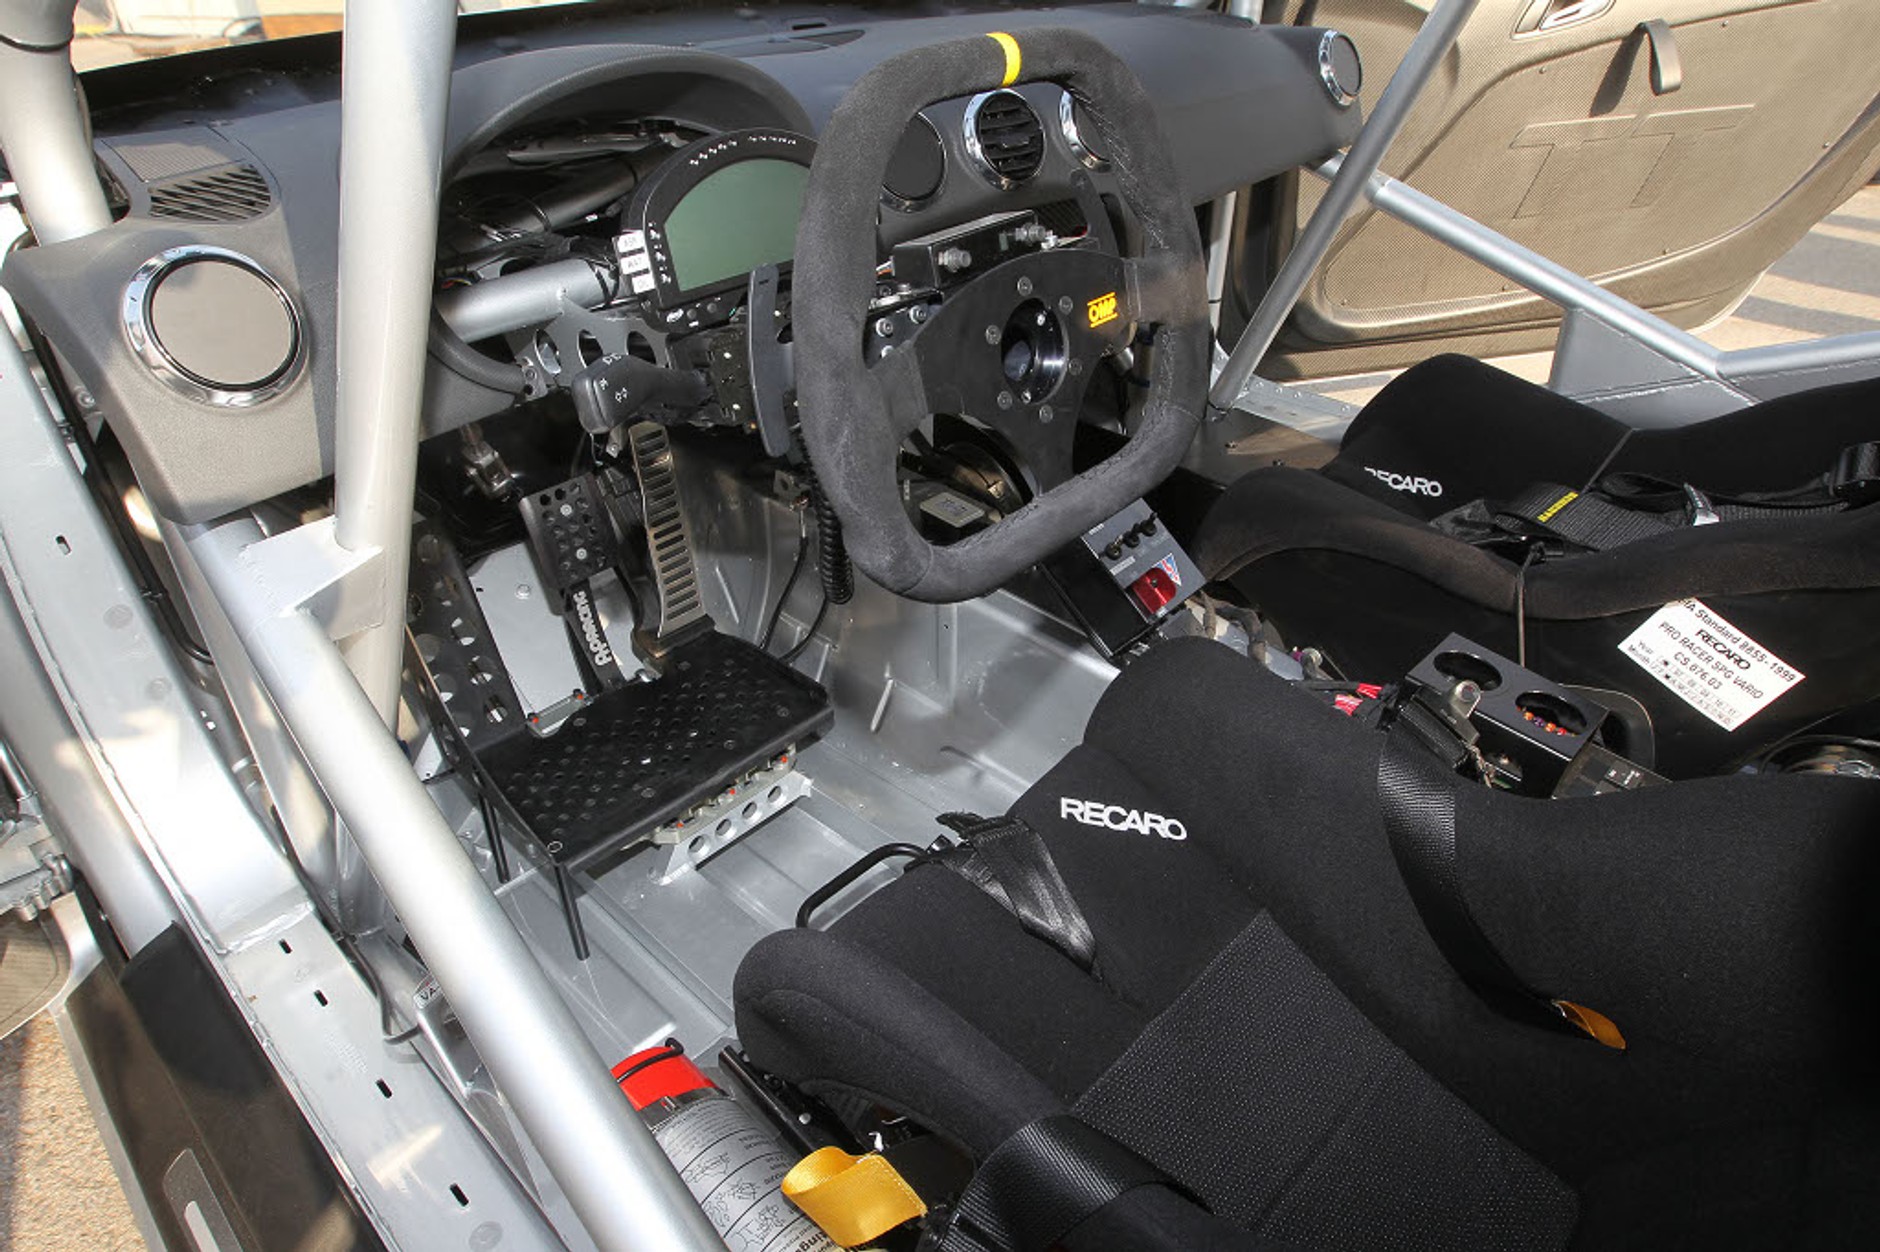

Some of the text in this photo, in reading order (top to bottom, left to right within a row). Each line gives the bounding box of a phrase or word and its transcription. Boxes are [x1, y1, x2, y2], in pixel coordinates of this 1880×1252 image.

[1509, 104, 1757, 220] TT
[1088, 295, 1117, 326] OMP
[1695, 608, 1741, 644] Standard
[1658, 621, 1681, 640] PRO
[1679, 636, 1714, 664] RACER
[1711, 660, 1734, 679] SPG
[1733, 674, 1764, 699] VARIO
[1695, 629, 1751, 670] RECARO
[1061, 797, 1187, 840] RECARO
